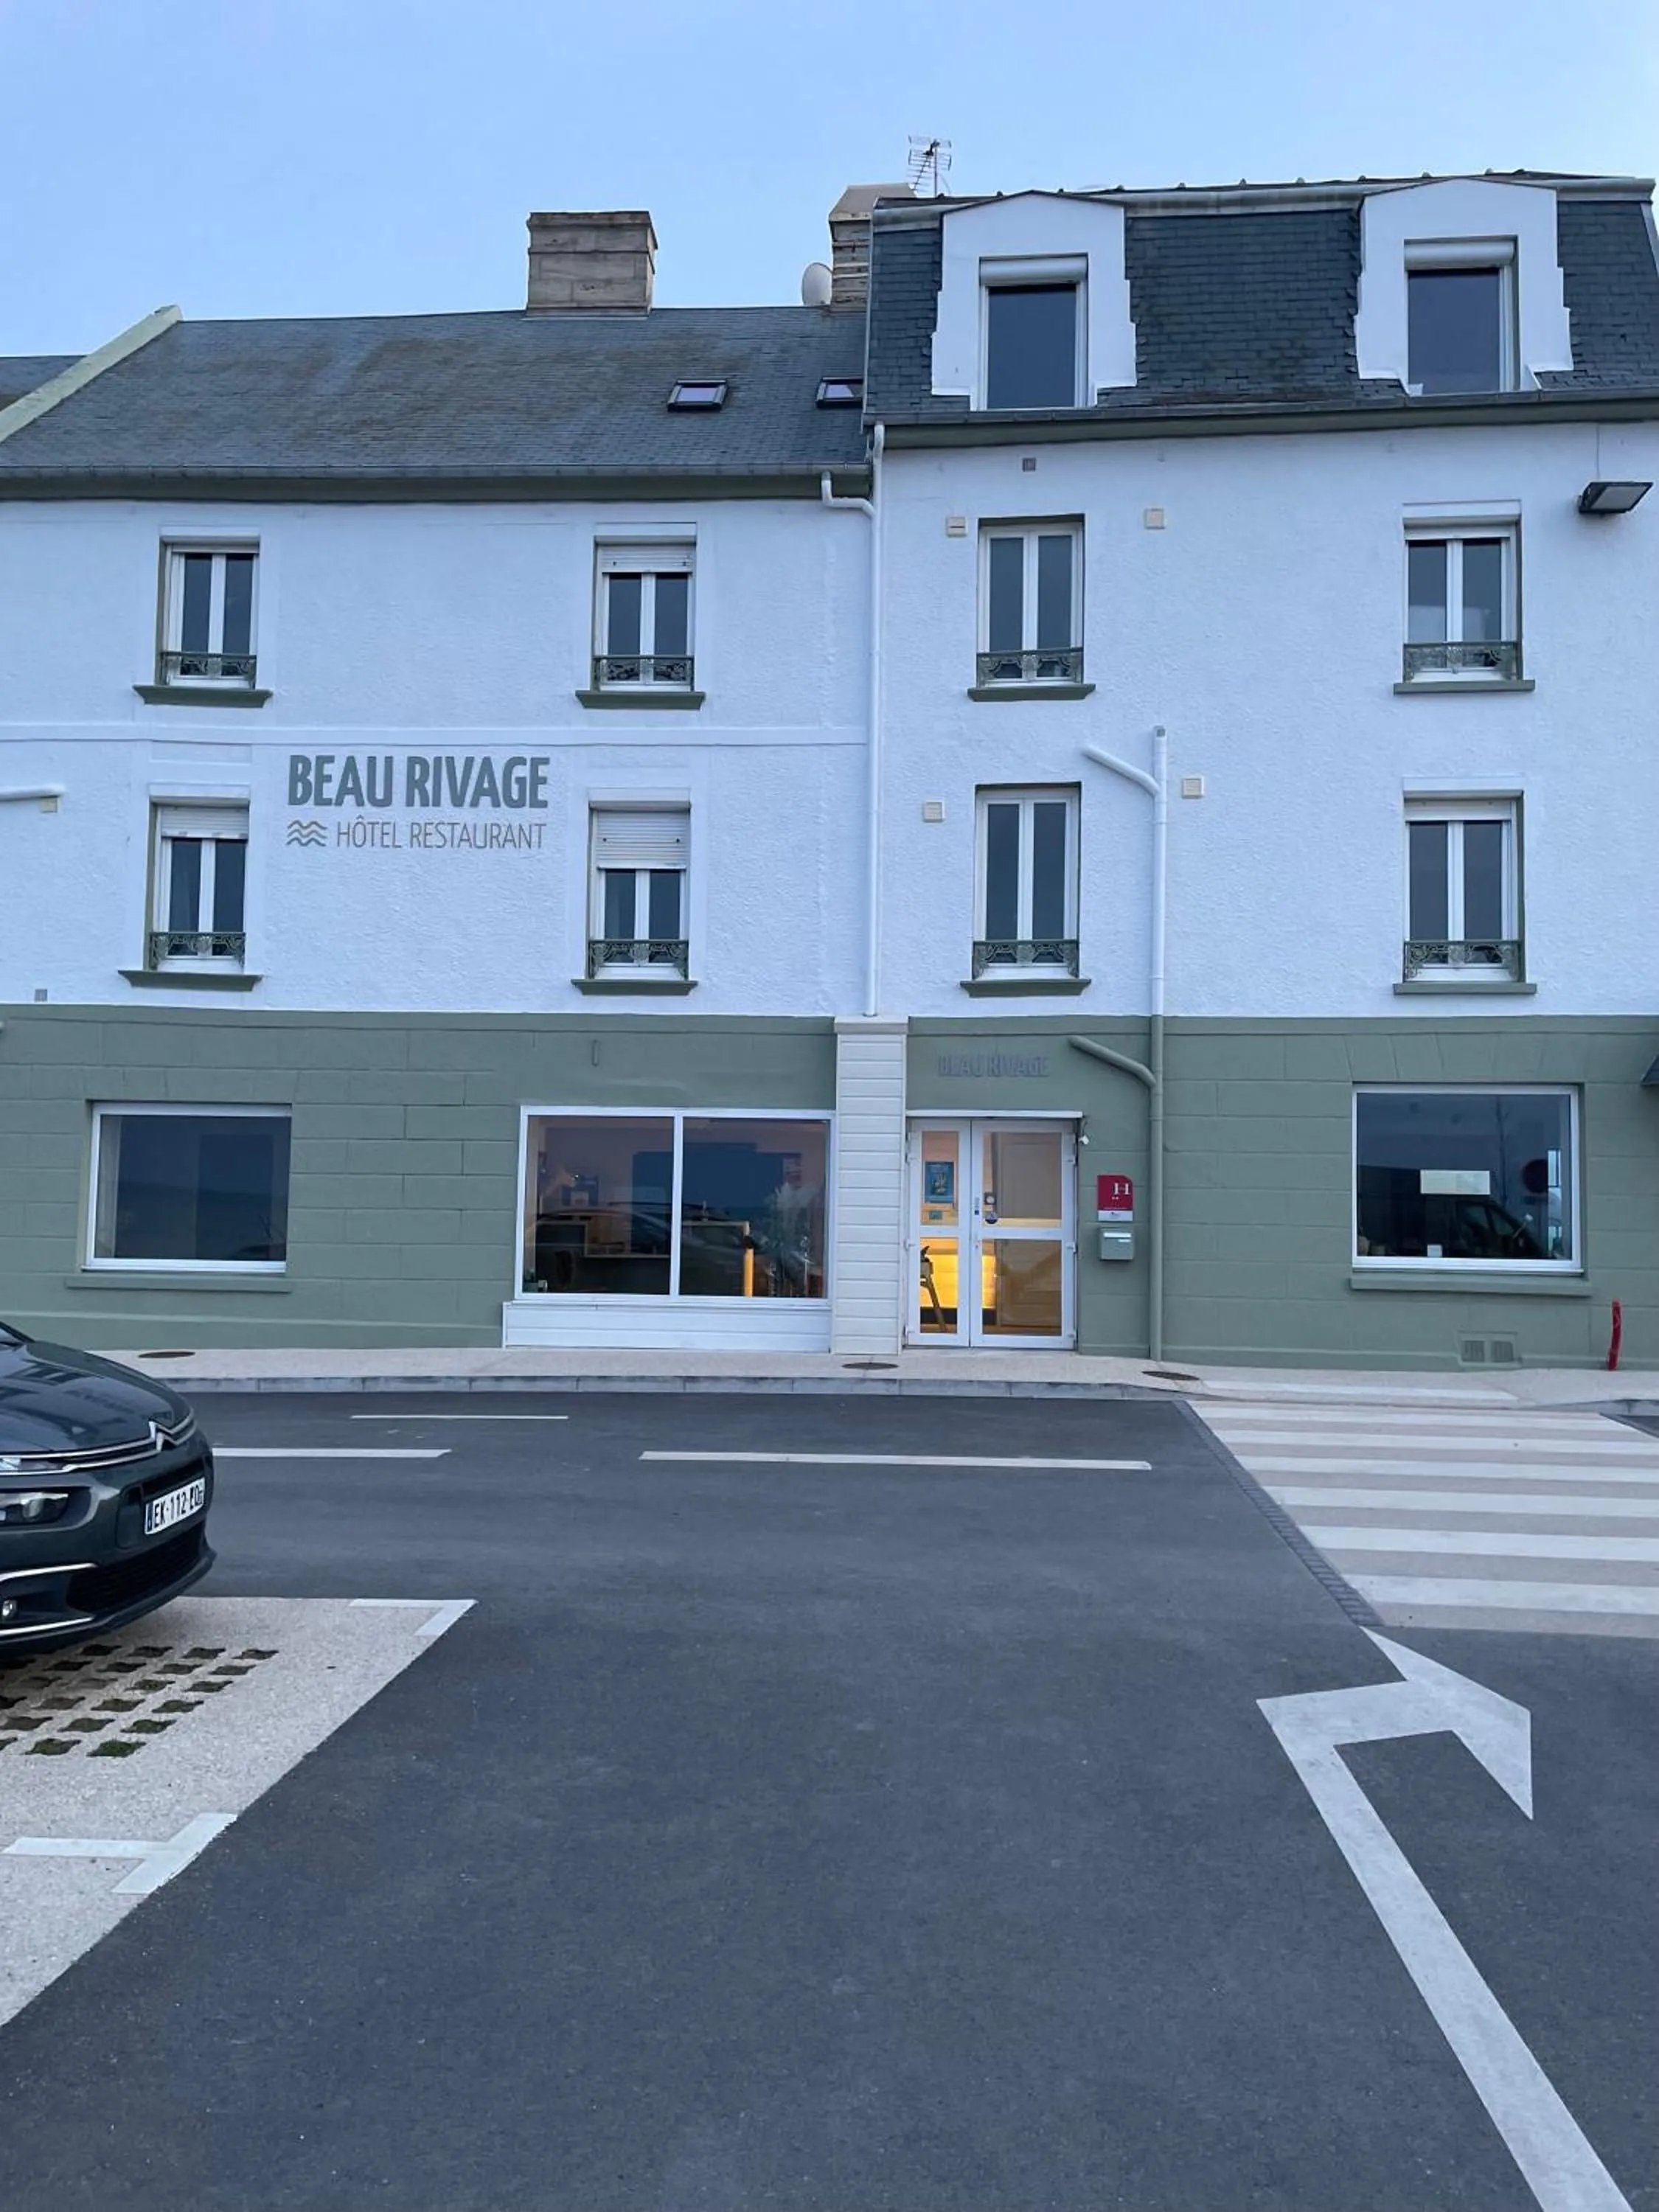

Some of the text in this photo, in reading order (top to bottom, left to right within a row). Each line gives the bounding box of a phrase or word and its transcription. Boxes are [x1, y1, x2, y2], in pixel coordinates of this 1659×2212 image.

[288, 754, 550, 809] BEAU RIVAGE
[336, 814, 547, 849] HÔTEL RESTAURANT
